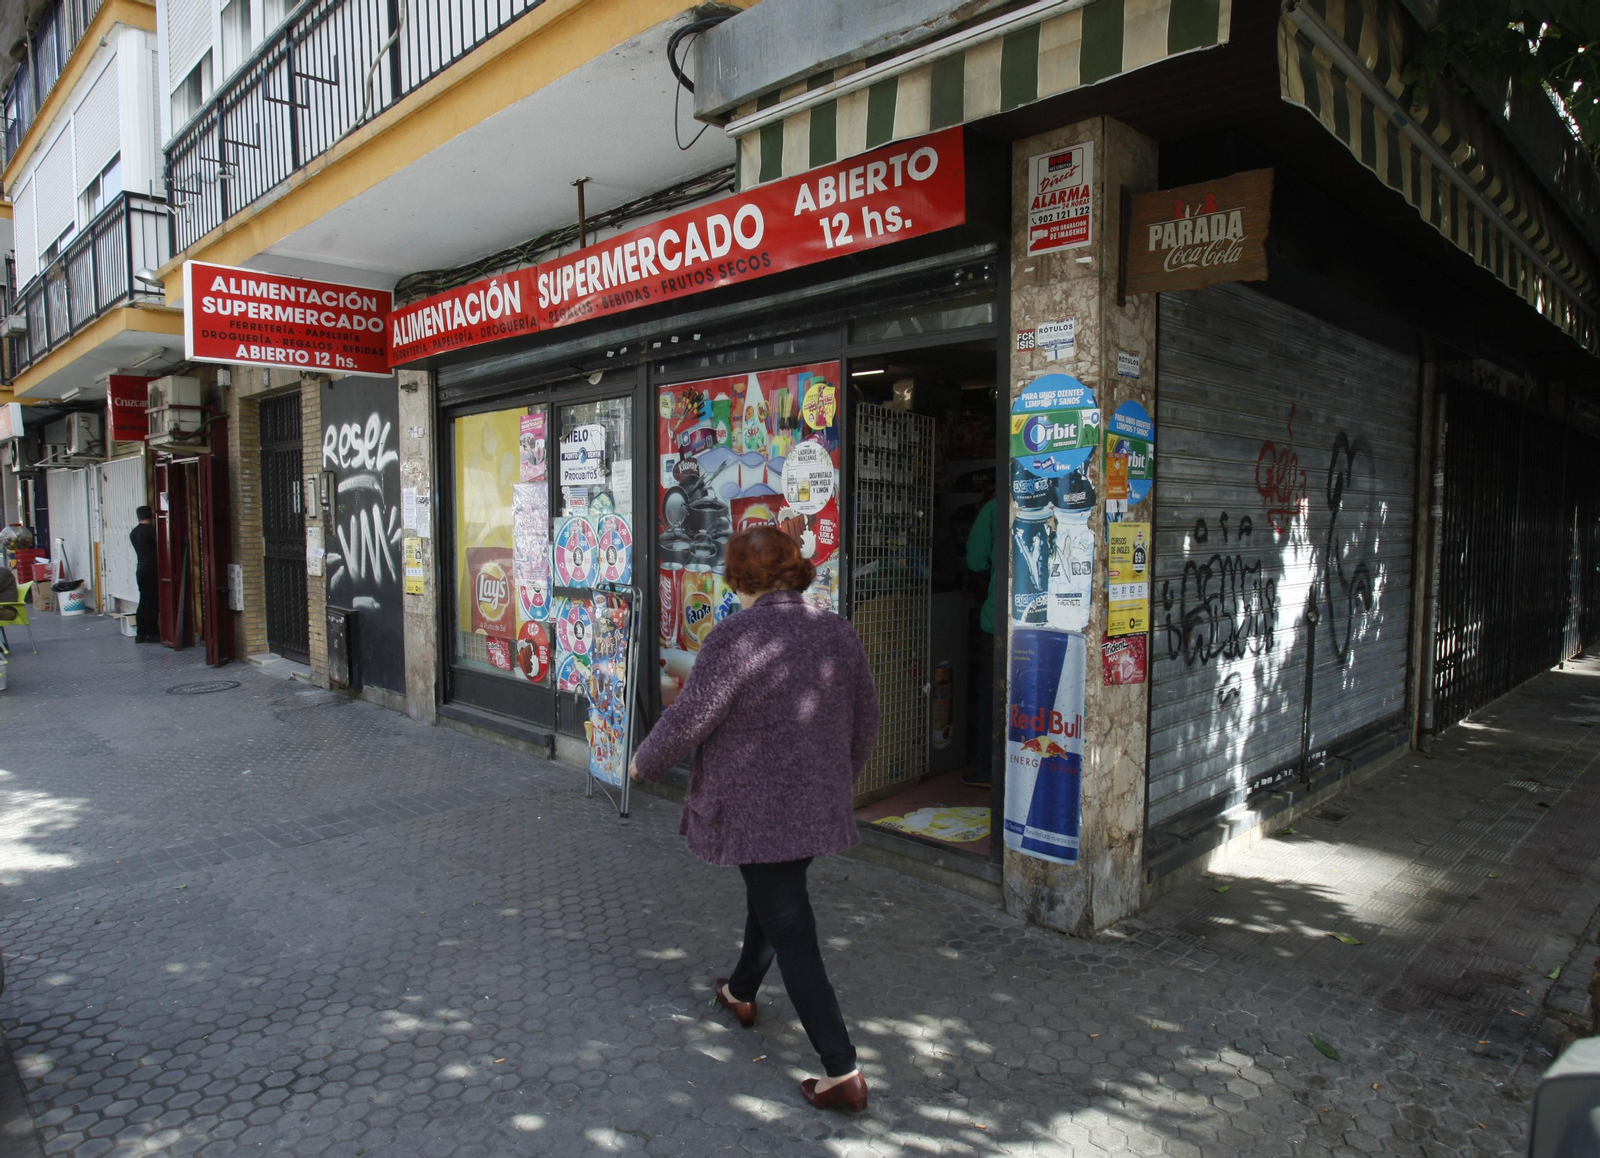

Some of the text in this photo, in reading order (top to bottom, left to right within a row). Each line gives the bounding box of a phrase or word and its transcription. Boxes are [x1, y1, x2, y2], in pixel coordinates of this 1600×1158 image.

[794, 146, 939, 216] ABIERTO
[1030, 184, 1090, 211] ALARMA
[819, 205, 912, 249] 12 hs.
[1038, 205, 1090, 224] 902 121 122
[1148, 210, 1244, 252] PARADA
[392, 203, 765, 348] ALIMENTACIÓN SUPERMERCADO
[210, 275, 377, 312] ALIMENTACIÓN
[433, 331, 474, 348] PAPELERÍA
[480, 315, 537, 339] DROGUERÍA
[548, 301, 594, 323] REGALOS
[601, 285, 651, 309] BEBIDAS
[660, 267, 715, 295] FRUTOS
[719, 252, 772, 279] SECOS
[202, 296, 384, 333] SUPERMERCADO
[201, 329, 384, 356] DROGUERÍA REGALOS BEBIDAS
[229, 320, 361, 342] FERRETERÍA PAPELERÍA
[1016, 331, 1035, 342] FCK
[1016, 339, 1035, 350] ISIS
[235, 344, 358, 369] ABIERTO 12 hs.
[1021, 392, 1038, 400] PARA
[1057, 388, 1084, 397] DIENTES
[1053, 398, 1058, 406] Y
[1058, 396, 1080, 405] SANOS
[1022, 415, 1077, 454] Orbit
[685, 604, 711, 625] Fanta
[1101, 638, 1129, 656] Trident
[1010, 703, 1081, 739] Red Bull
